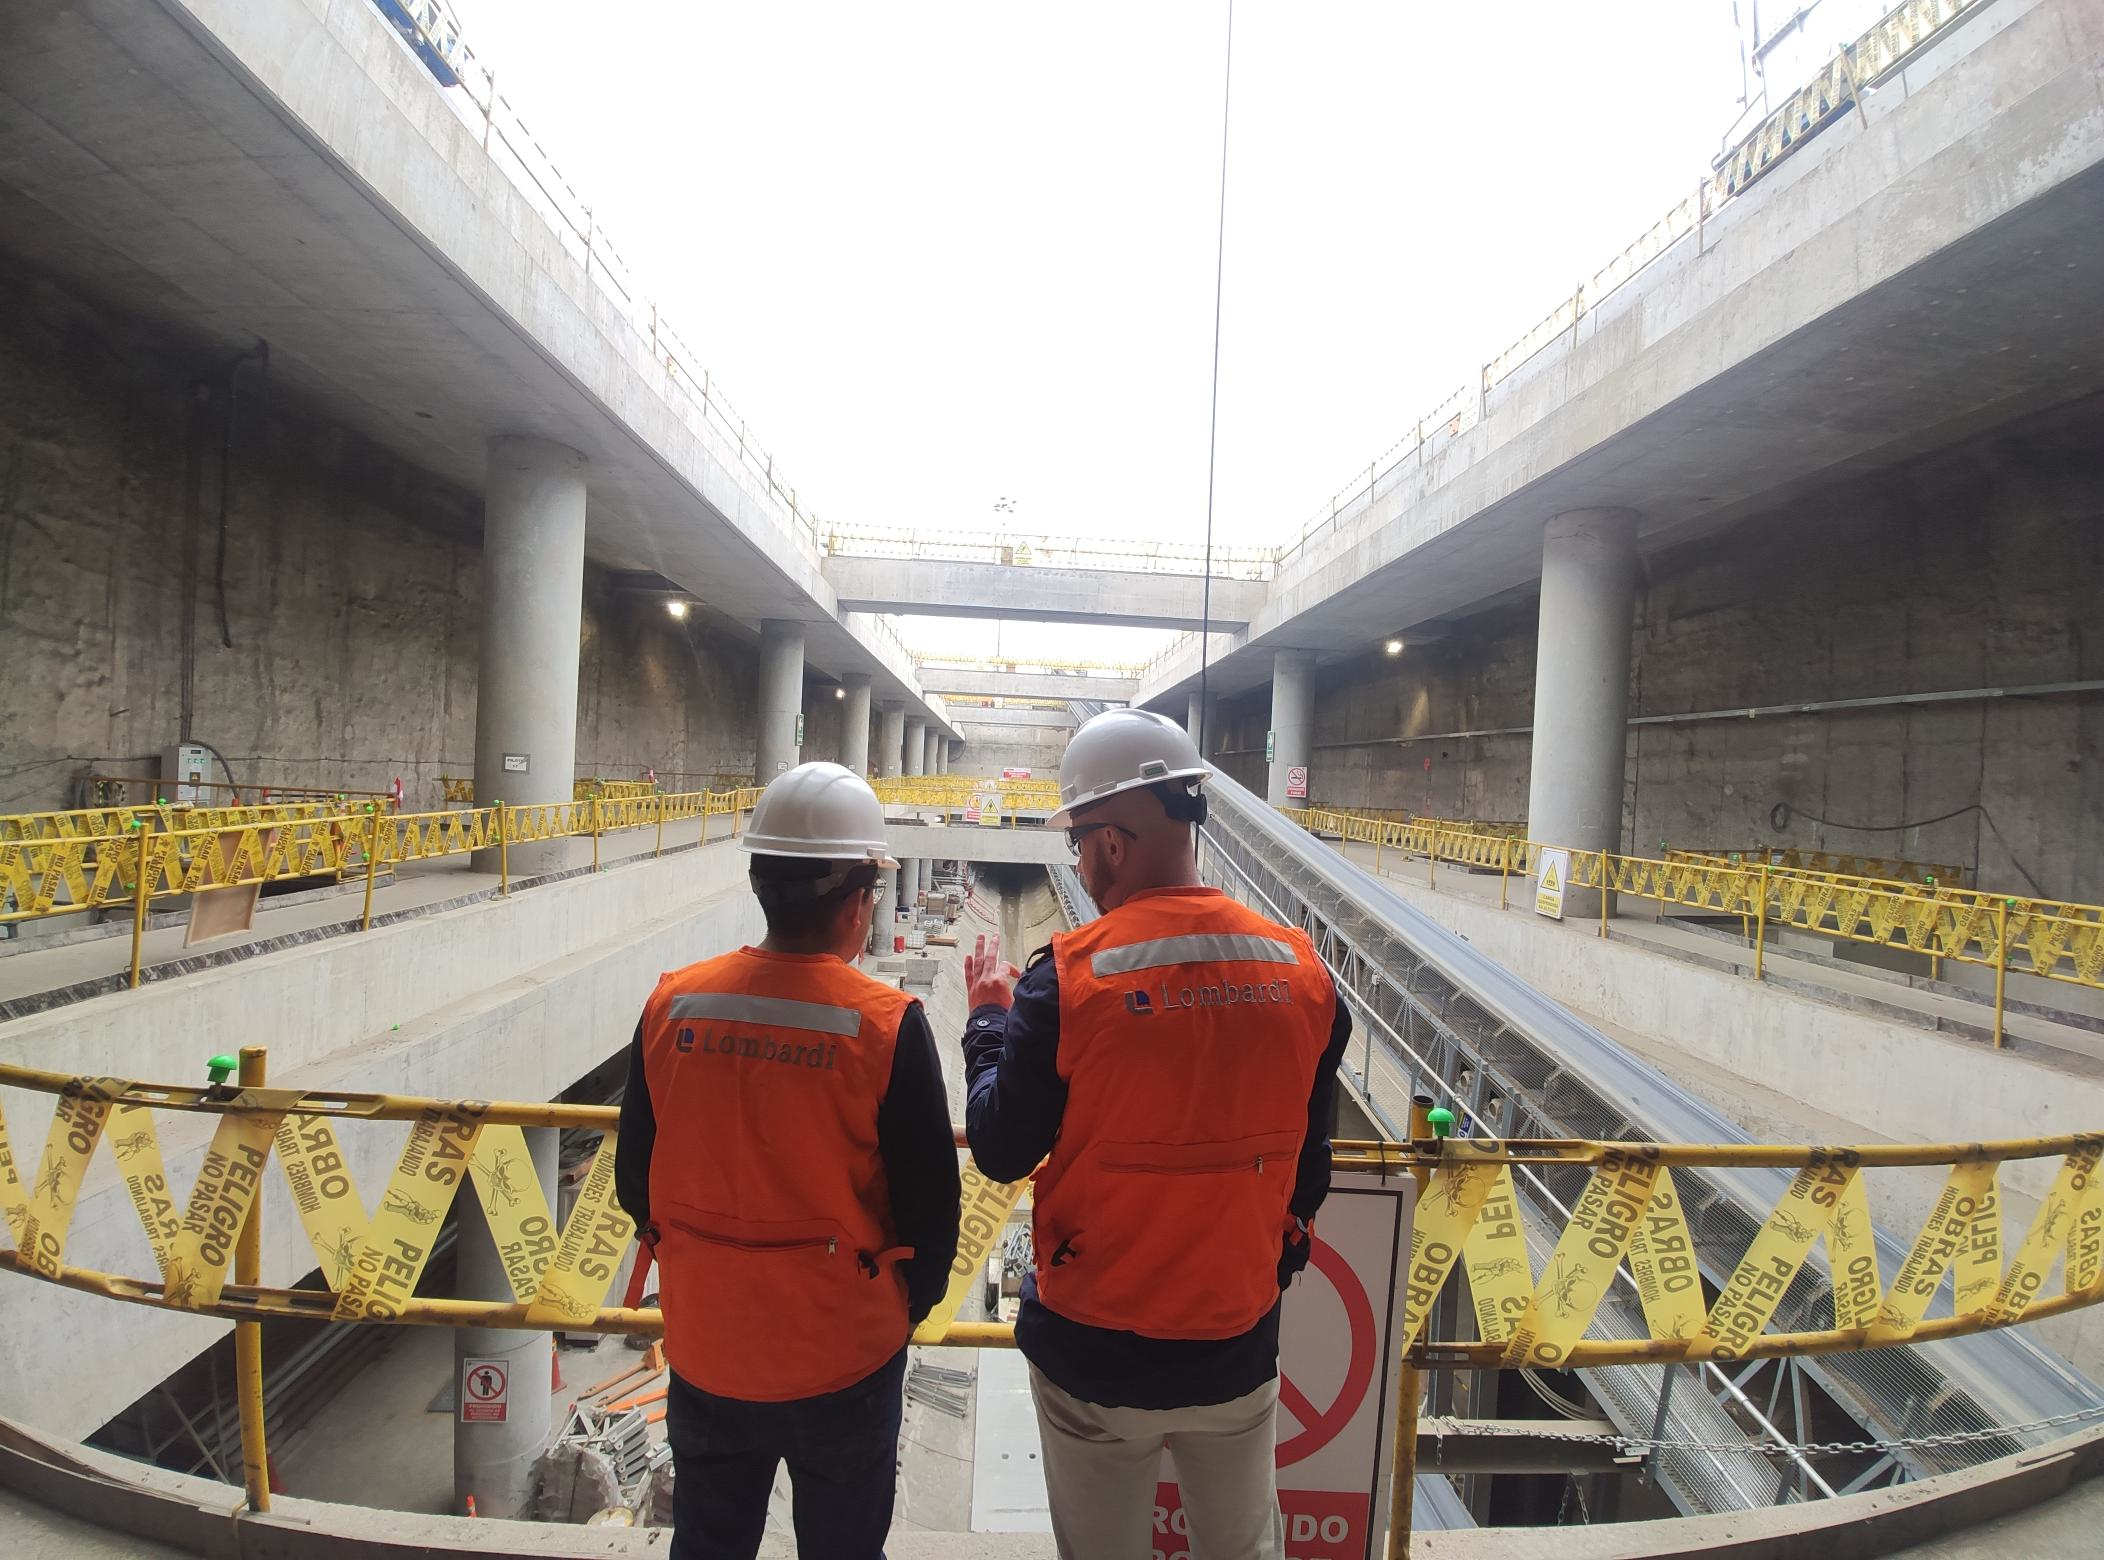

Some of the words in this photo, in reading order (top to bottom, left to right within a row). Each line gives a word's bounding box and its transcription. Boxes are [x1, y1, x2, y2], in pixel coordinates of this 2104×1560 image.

[45, 871, 61, 899] PASAR
[55, 855, 66, 868] NO
[97, 886, 107, 898] NO
[1162, 978, 1294, 1011] Lombardi
[704, 1027, 836, 1070] Lombardi
[203, 1151, 229, 1179] NO
[401, 1107, 442, 1177] TRABAJANDO
[1602, 1147, 1626, 1173] NO
[583, 1150, 615, 1204] HOMBRES
[182, 1180, 219, 1236] PASAR
[201, 1144, 265, 1267] PELIGRO
[952, 1176, 1018, 1277] ELIGRO
[1572, 1174, 1614, 1232] PASAR
[1587, 1147, 1660, 1259] PELIGRO
[1928, 1185, 1960, 1232] HOMBRES
[357, 1245, 384, 1274] NO
[553, 1205, 596, 1273] TRABAJANDO
[1894, 1235, 1935, 1294] TRABAJANDO
[1913, 1196, 1976, 1297] OBRAS
[334, 1273, 373, 1320] PASA
[1735, 1260, 1761, 1288] NO
[1701, 1288, 1743, 1339] PASAR
[1711, 1255, 1794, 1360] PELIGRO
